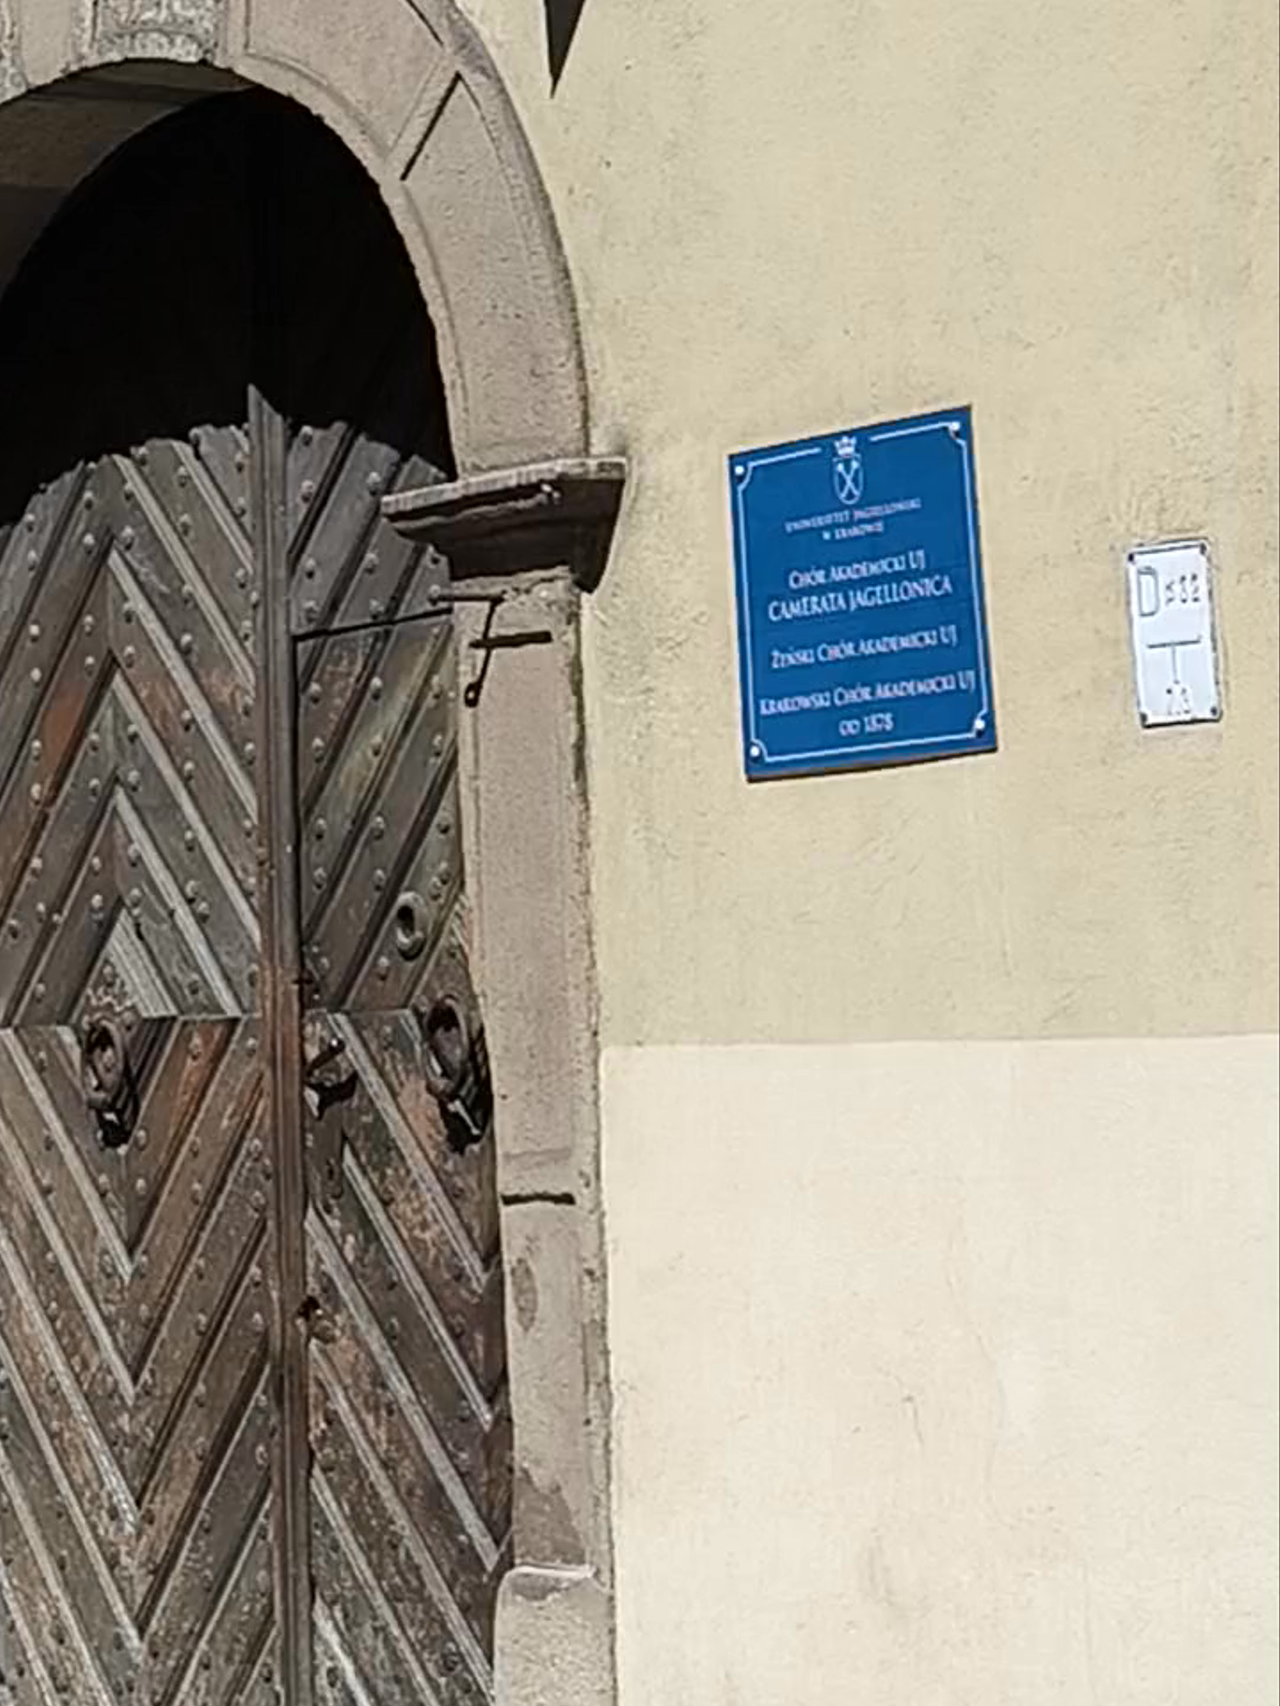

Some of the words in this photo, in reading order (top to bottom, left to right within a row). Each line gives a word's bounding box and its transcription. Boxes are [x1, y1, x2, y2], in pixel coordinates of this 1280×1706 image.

[789, 567, 826, 589] CHÓR
[830, 555, 906, 582] AKADEMICKI
[908, 549, 925, 570] UJ
[1137, 566, 1161, 617] D
[768, 592, 846, 621] CAMERATA
[849, 575, 953, 611] JAGELLONICA
[817, 639, 856, 662] CHÓR
[858, 629, 937, 656] AKADEMICKI
[940, 624, 957, 646] UJ
[759, 692, 831, 715] KRAKOWSKI
[833, 683, 872, 706] CHÓR
[875, 673, 955, 700] AKADEMICKI
[958, 669, 975, 692] UJ
